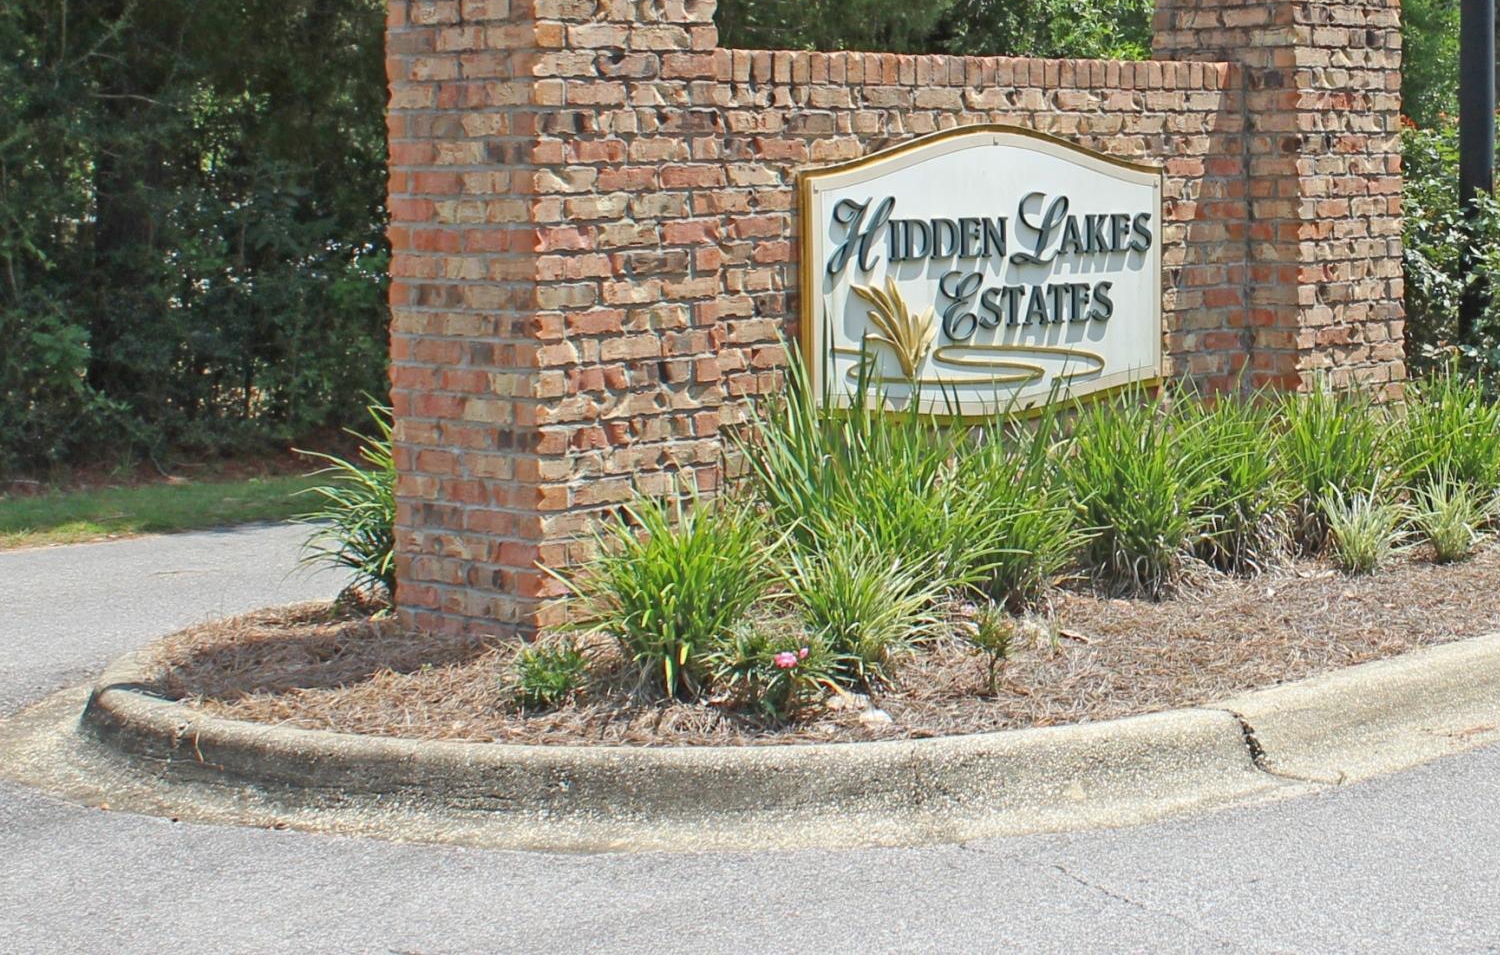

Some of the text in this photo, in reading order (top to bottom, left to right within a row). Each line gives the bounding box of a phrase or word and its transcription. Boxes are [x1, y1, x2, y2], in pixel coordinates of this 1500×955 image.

[827, 192, 1153, 275] HIDDEN LAKES
[939, 270, 1113, 341] ESTATES
